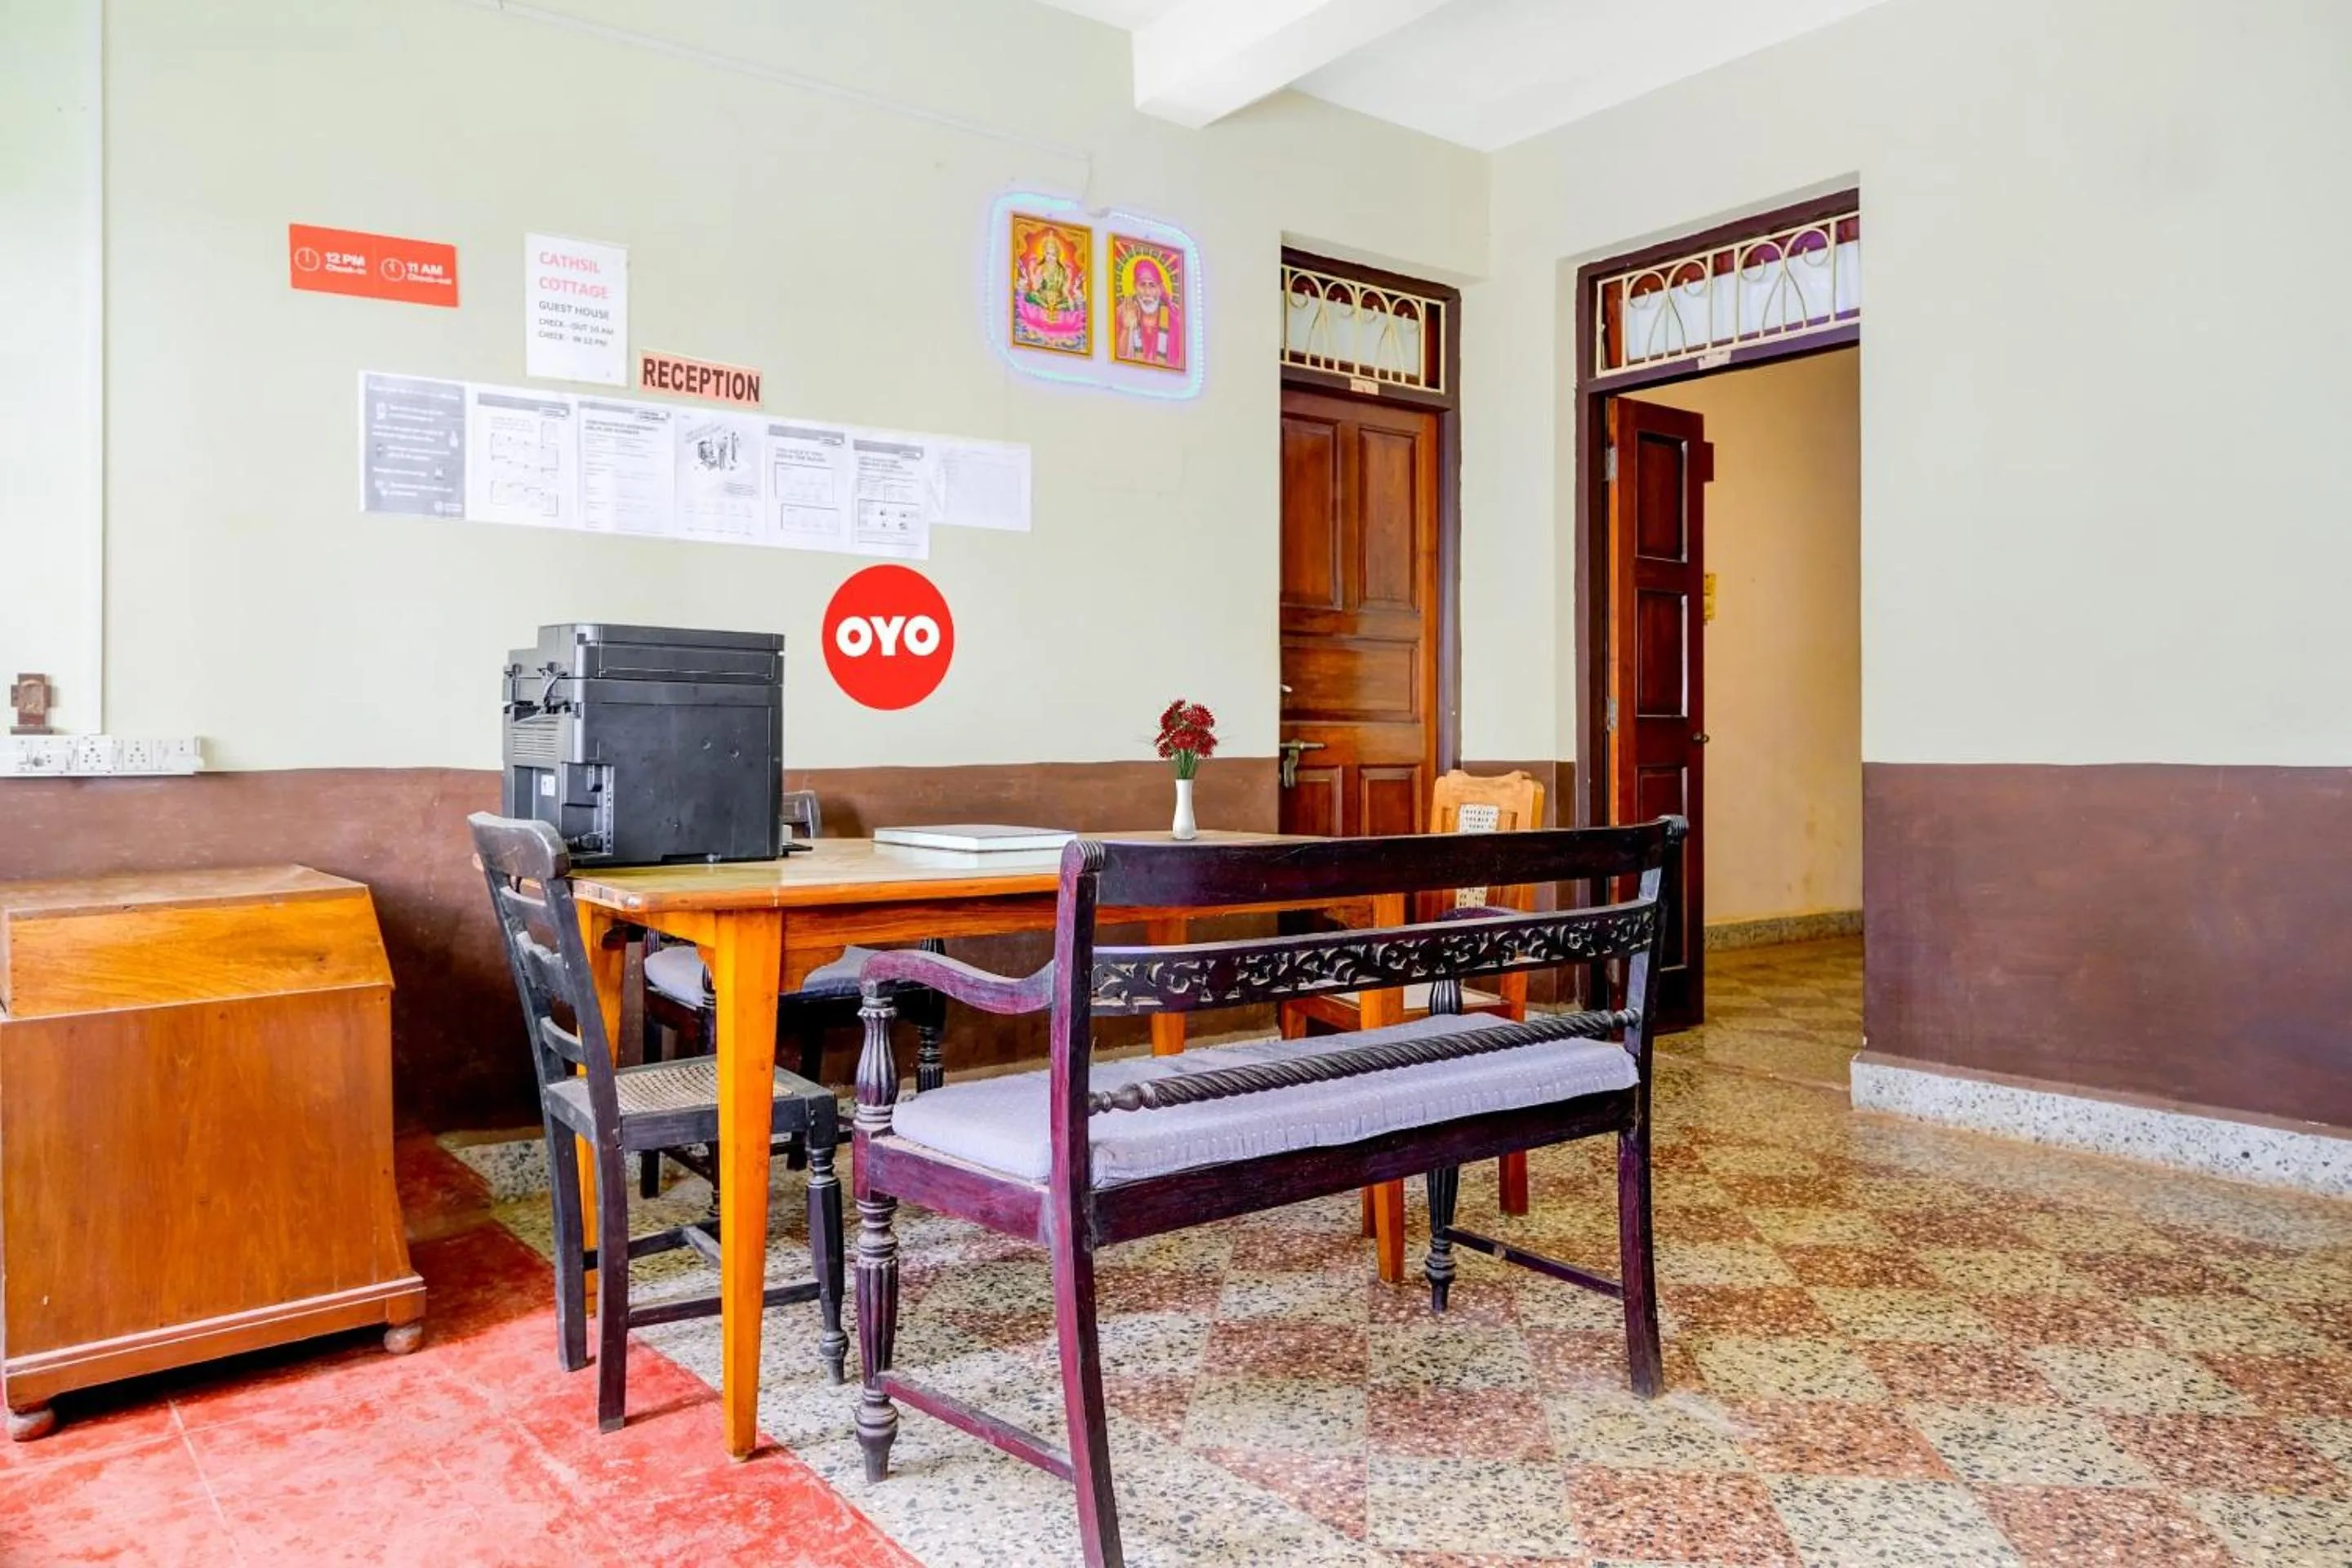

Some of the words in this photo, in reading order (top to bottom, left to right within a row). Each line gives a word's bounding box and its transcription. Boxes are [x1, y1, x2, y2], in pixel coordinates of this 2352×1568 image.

[326, 252, 341, 263] 12
[343, 254, 366, 266] PM
[421, 265, 443, 275] AM
[539, 277, 609, 299] COTTAGE
[539, 300, 572, 314] GUEST
[575, 306, 609, 320] HOUSE
[643, 358, 760, 402] RECEPTION
[836, 615, 940, 657] OYO
